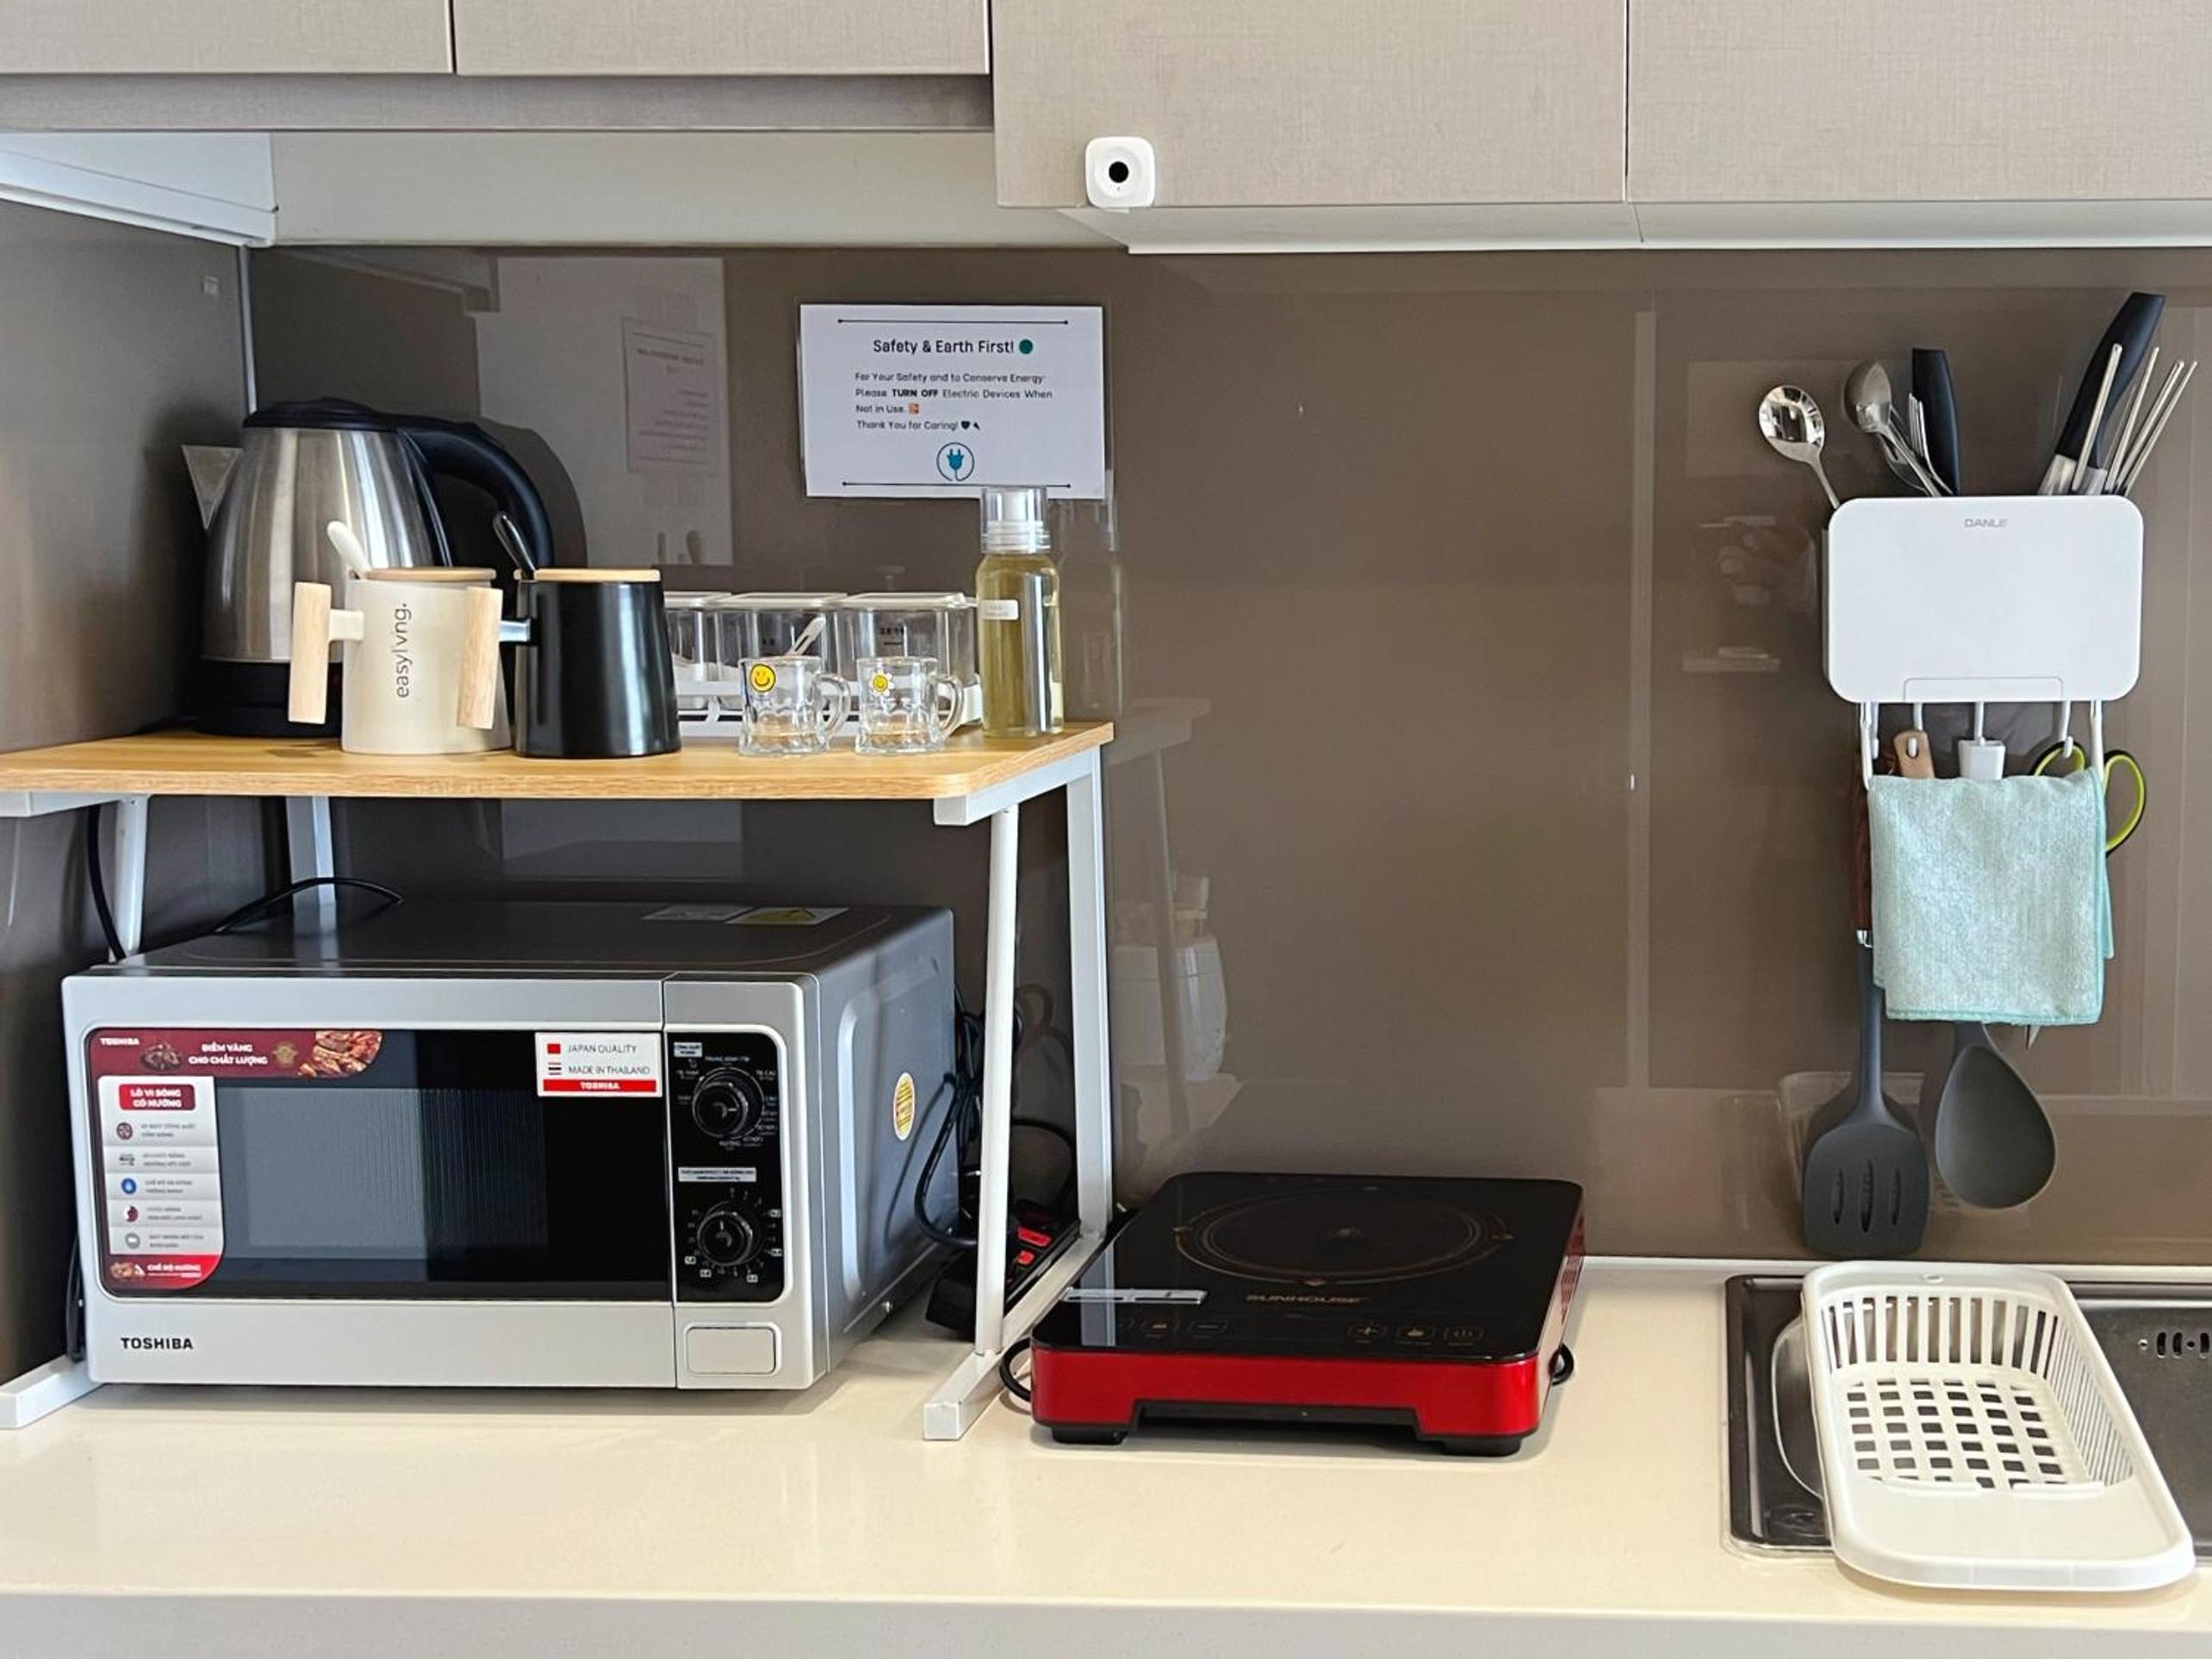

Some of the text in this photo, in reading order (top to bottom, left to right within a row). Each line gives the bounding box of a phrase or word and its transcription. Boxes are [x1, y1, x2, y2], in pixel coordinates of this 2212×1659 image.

[873, 339, 1014, 354] Safety & Earth First!
[897, 373, 927, 383] Safety
[929, 373, 948, 382] and
[855, 388, 887, 397] Please
[892, 388, 917, 397] TURN
[921, 388, 938, 397] OFF
[942, 389, 979, 398] Electric
[983, 389, 1020, 398] Devices
[857, 420, 958, 432] Thank You for Caring!
[1965, 519, 2007, 527] DANLE
[568, 1044, 637, 1053] JAPAN QUALITY
[569, 1066, 650, 1075] MADE IN THAILAND
[580, 1081, 620, 1090] TOSHIBA
[121, 1336, 194, 1350] TOSHIBA
